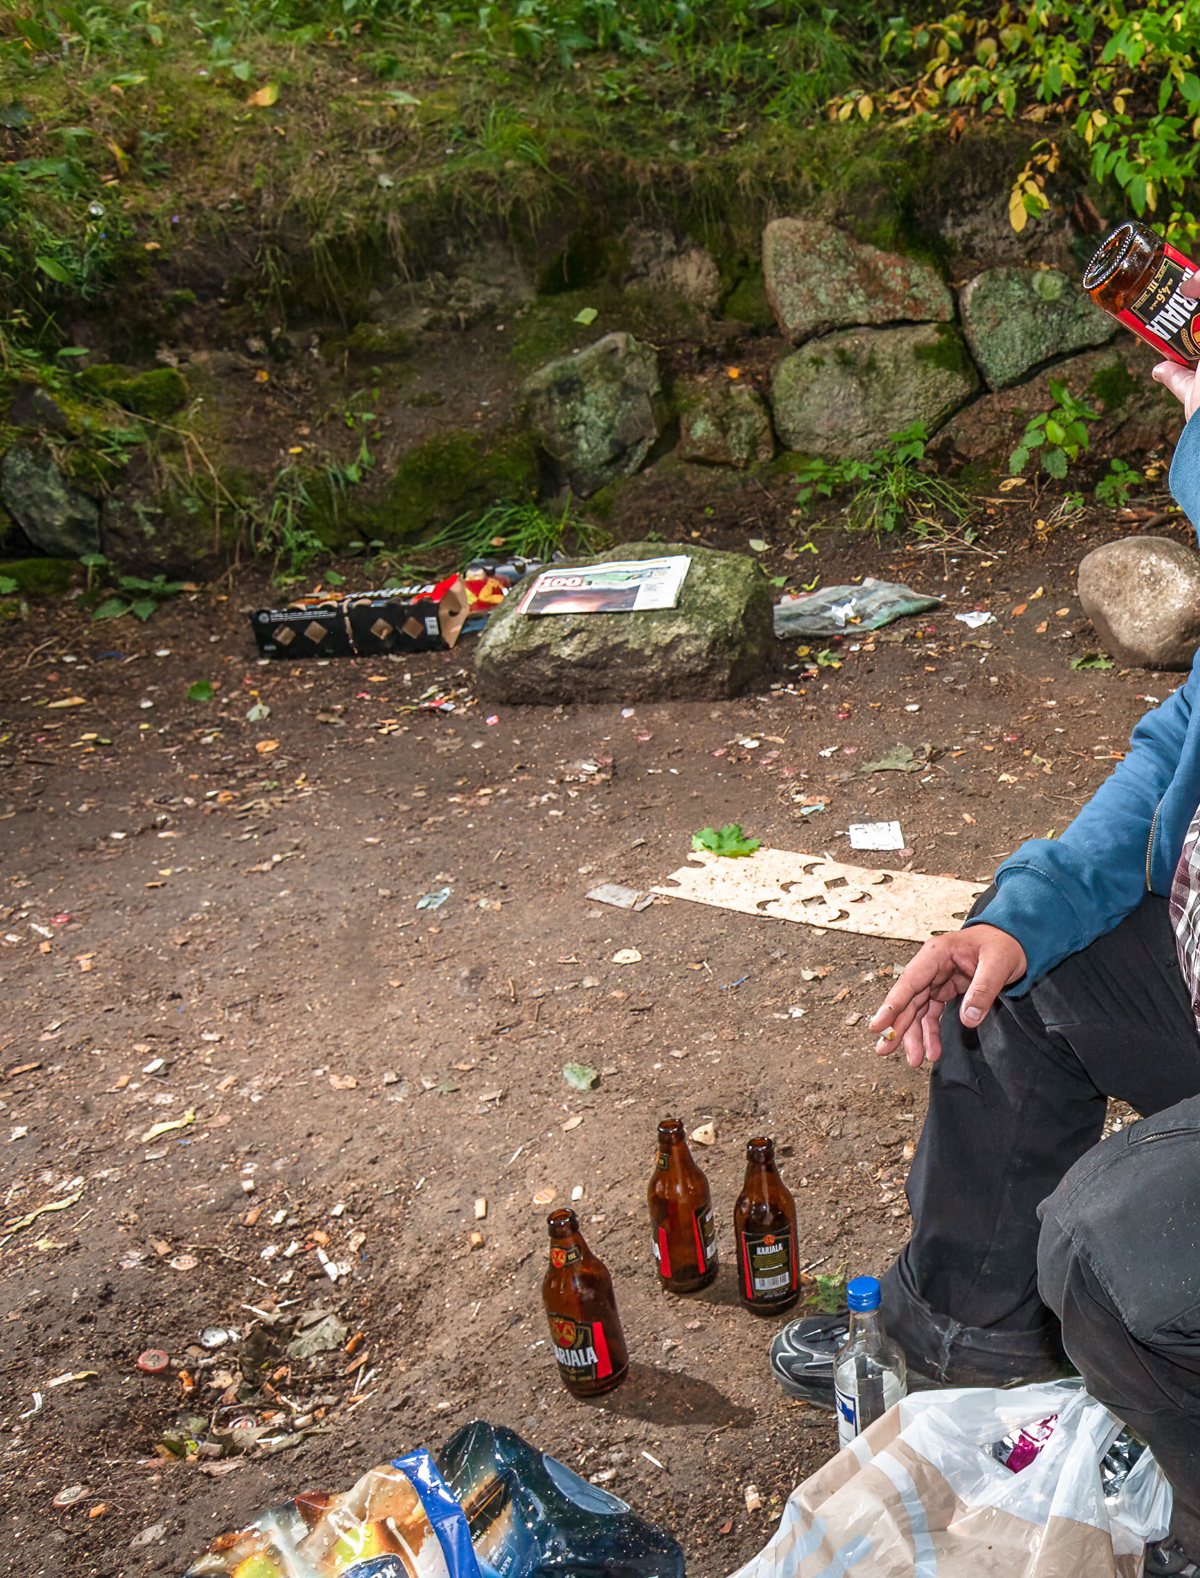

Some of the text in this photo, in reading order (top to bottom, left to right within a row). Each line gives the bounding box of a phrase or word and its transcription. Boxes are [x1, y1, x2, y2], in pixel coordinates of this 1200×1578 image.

[1144, 266, 1198, 341] RJALA
[756, 1243, 783, 1255] KARJALA
[553, 1343, 598, 1367] ARJALA
